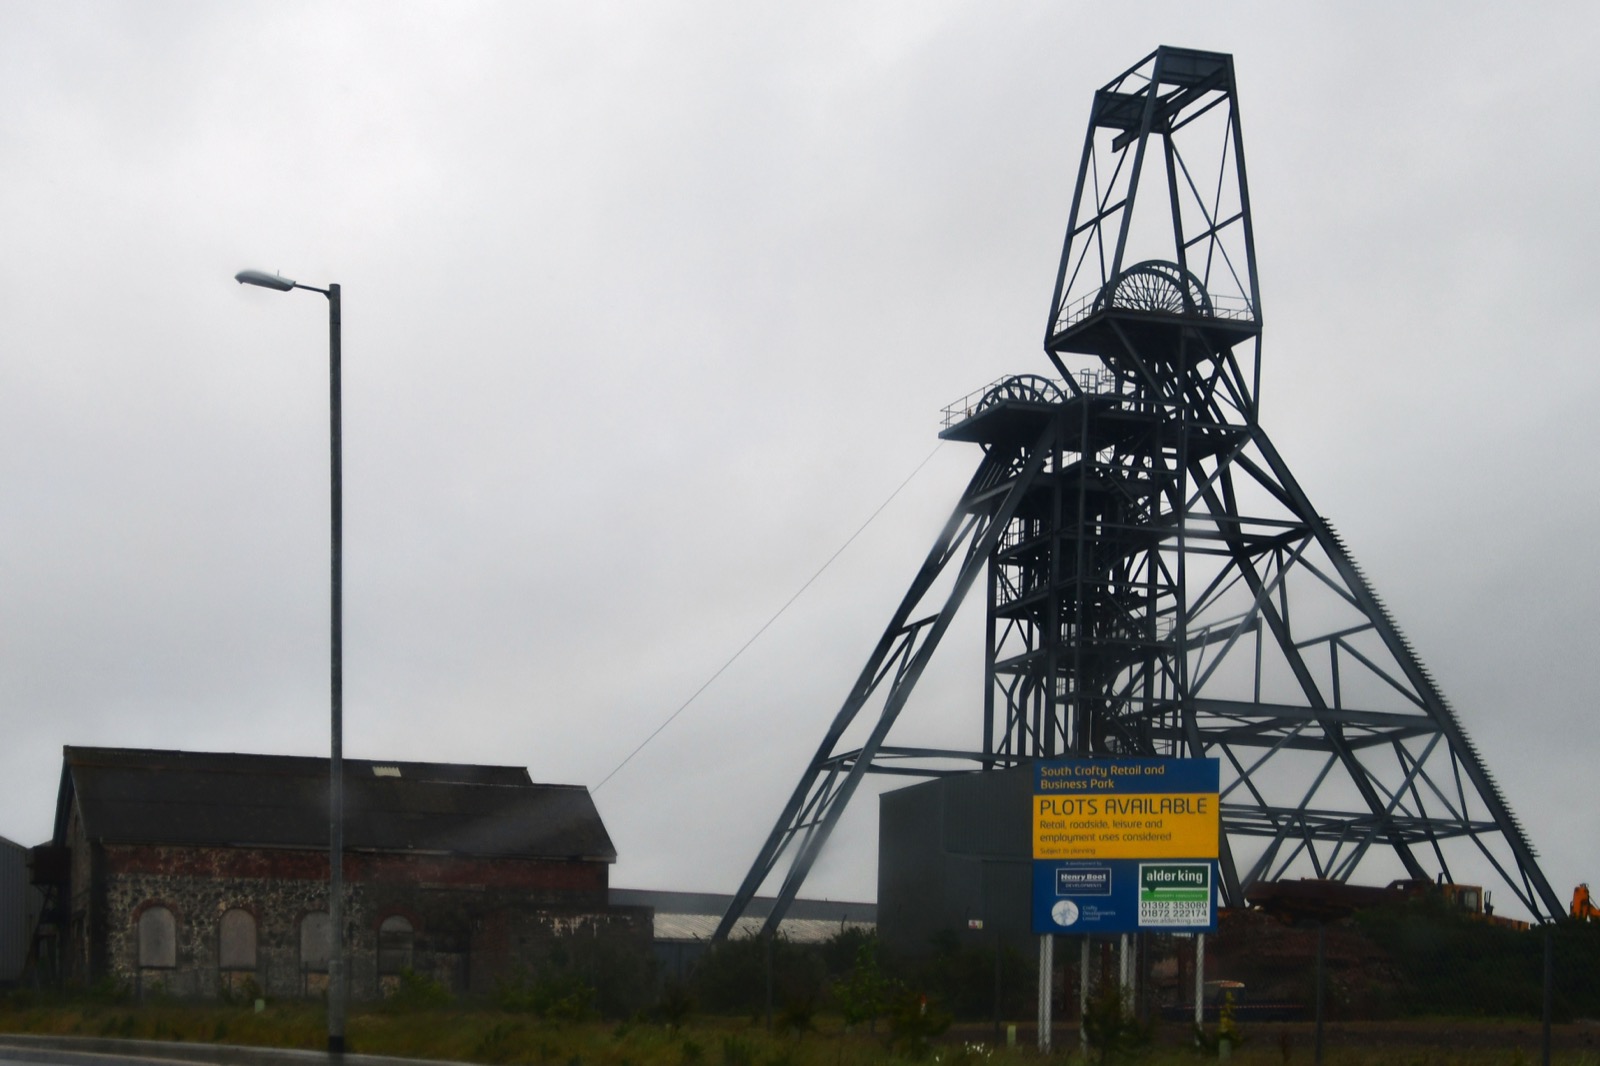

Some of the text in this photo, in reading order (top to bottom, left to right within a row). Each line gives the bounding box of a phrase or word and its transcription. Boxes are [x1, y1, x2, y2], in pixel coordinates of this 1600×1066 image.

[1041, 764, 1165, 778] South Crofty Retail and
[1040, 778, 1114, 789] Business Park
[1040, 797, 1207, 815] PLOTS AVAILABLE
[1040, 820, 1066, 829] Retail,
[1113, 820, 1142, 828] leisure
[1145, 819, 1162, 828] and
[1040, 832, 1171, 844] employment uses considered
[1070, 847, 1096, 855] planning
[1061, 873, 1106, 882] Henry Boot
[1146, 869, 1203, 883] alder king
[1173, 901, 1207, 909] 353080
